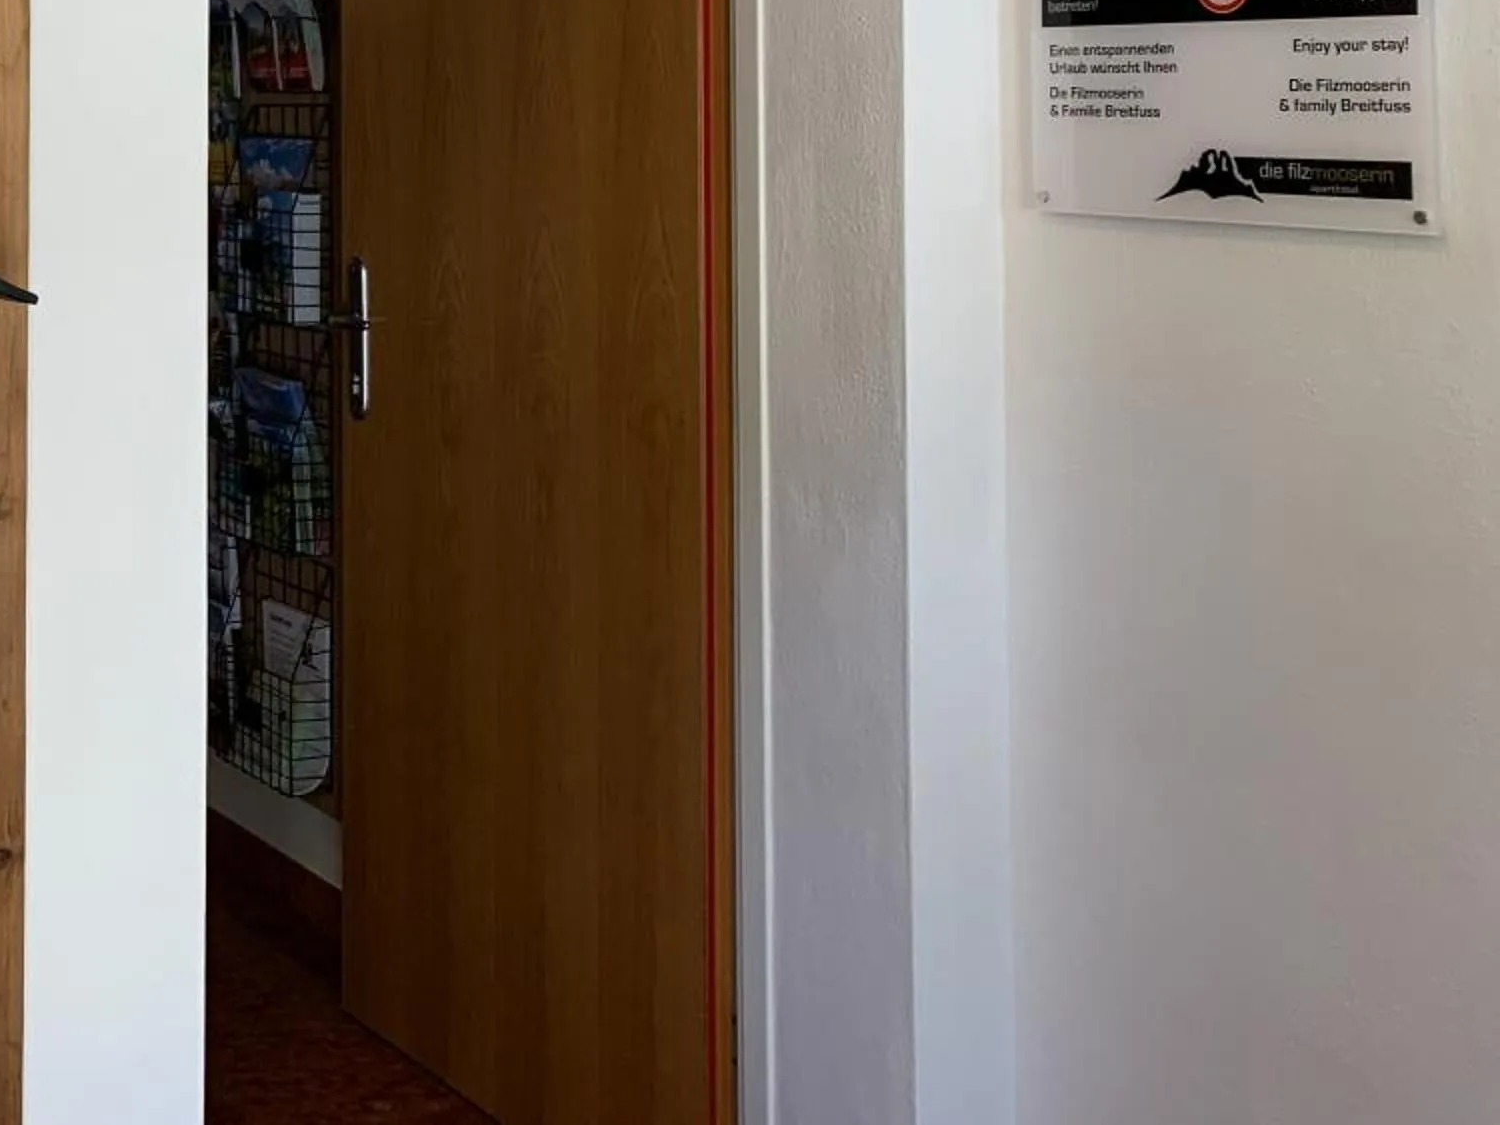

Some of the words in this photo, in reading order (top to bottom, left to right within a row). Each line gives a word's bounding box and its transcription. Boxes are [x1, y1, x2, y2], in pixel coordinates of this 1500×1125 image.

[1049, 44, 1080, 57] Einen
[1292, 38, 1331, 56] Enjoy
[1333, 40, 1368, 56] your
[1371, 36, 1410, 54] stay!
[1049, 61, 1088, 74] Urlaub
[1143, 60, 1178, 74] Ihnen
[1289, 78, 1313, 92] Die
[1316, 78, 1411, 92] Filzmooserin
[1049, 86, 1069, 99] Die
[1050, 104, 1059, 117] &
[1105, 104, 1161, 118] Breitfuss
[1279, 98, 1290, 112] &
[1294, 98, 1337, 116] family
[1341, 98, 1411, 114] Breitfuss
[1259, 161, 1284, 180] die
[1287, 161, 1395, 185] filzmooserin
